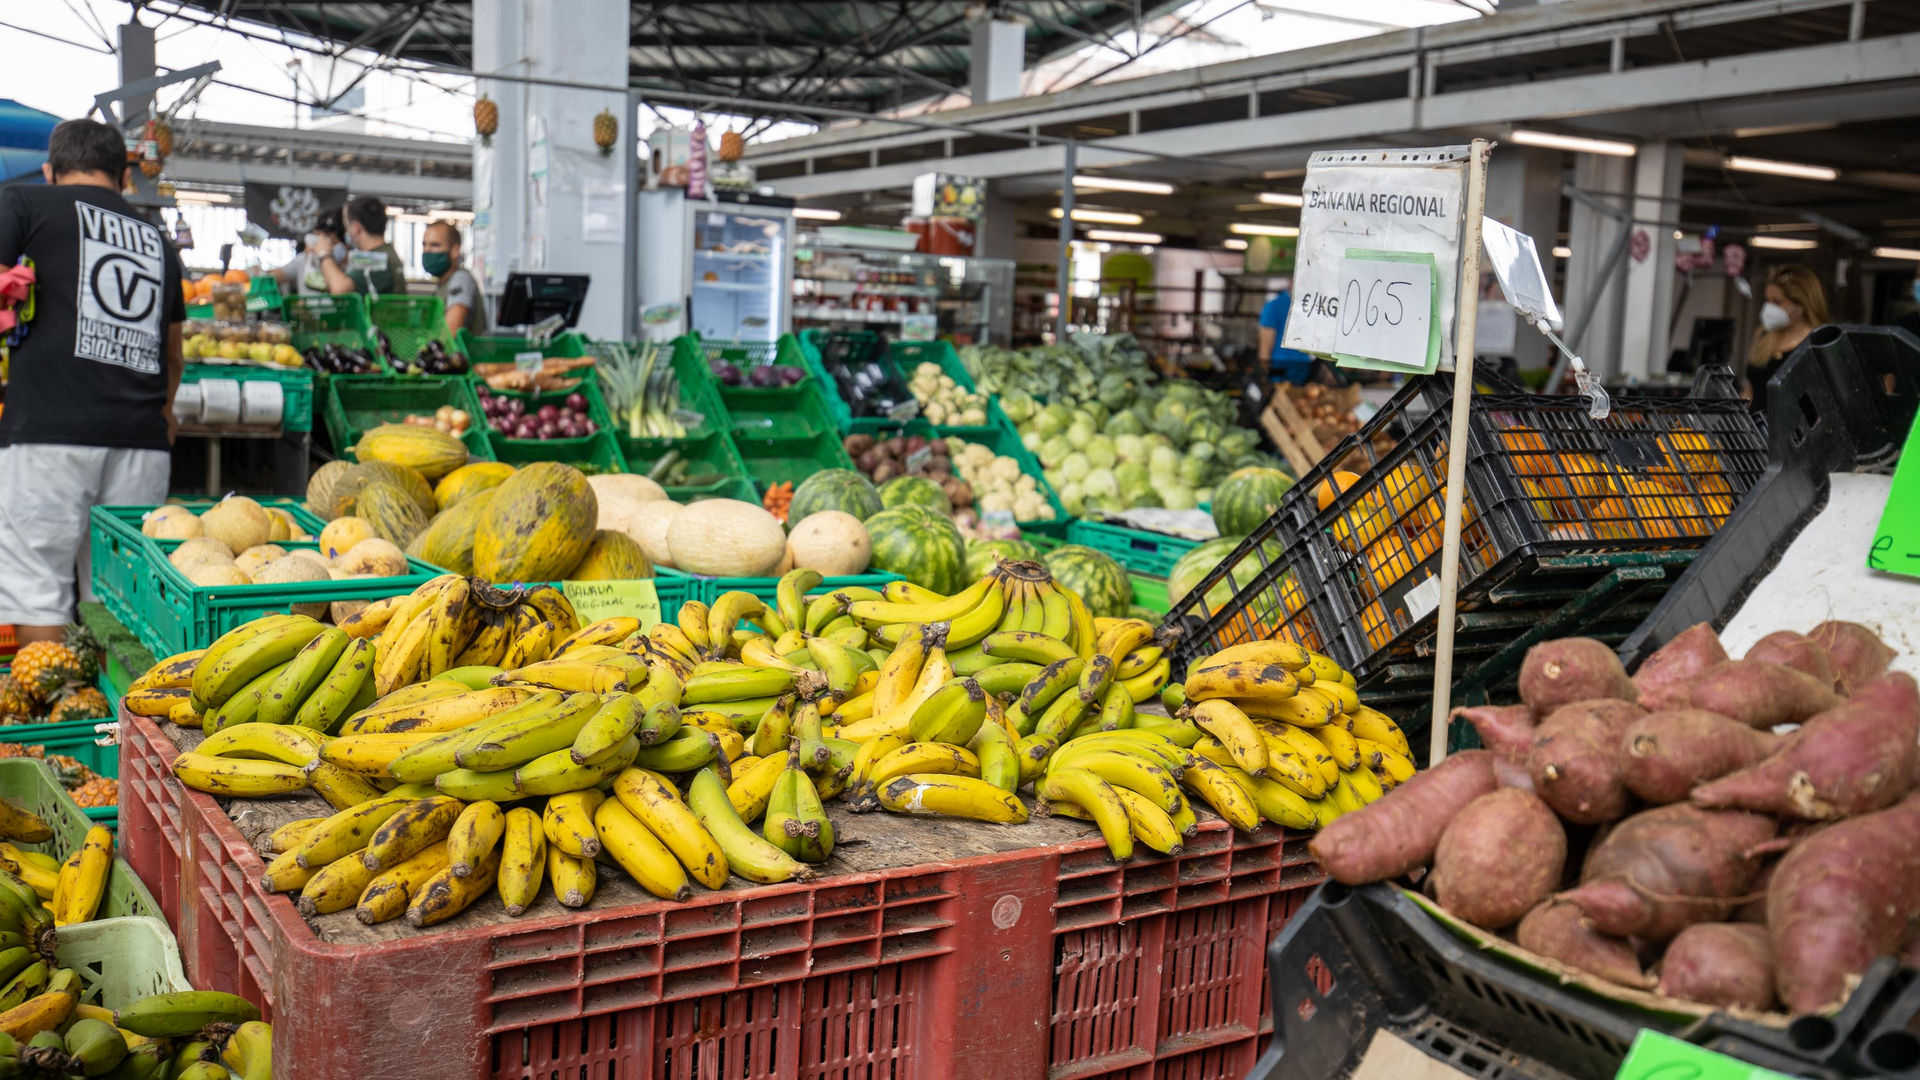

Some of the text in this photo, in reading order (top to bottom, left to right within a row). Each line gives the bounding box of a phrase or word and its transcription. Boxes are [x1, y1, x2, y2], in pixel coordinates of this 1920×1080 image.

[1309, 190, 1446, 218] BANANA REGIONAL
[81, 205, 160, 259] VANS
[1302, 292, 1339, 318] €/KG
[81, 335, 125, 362] SINCE
